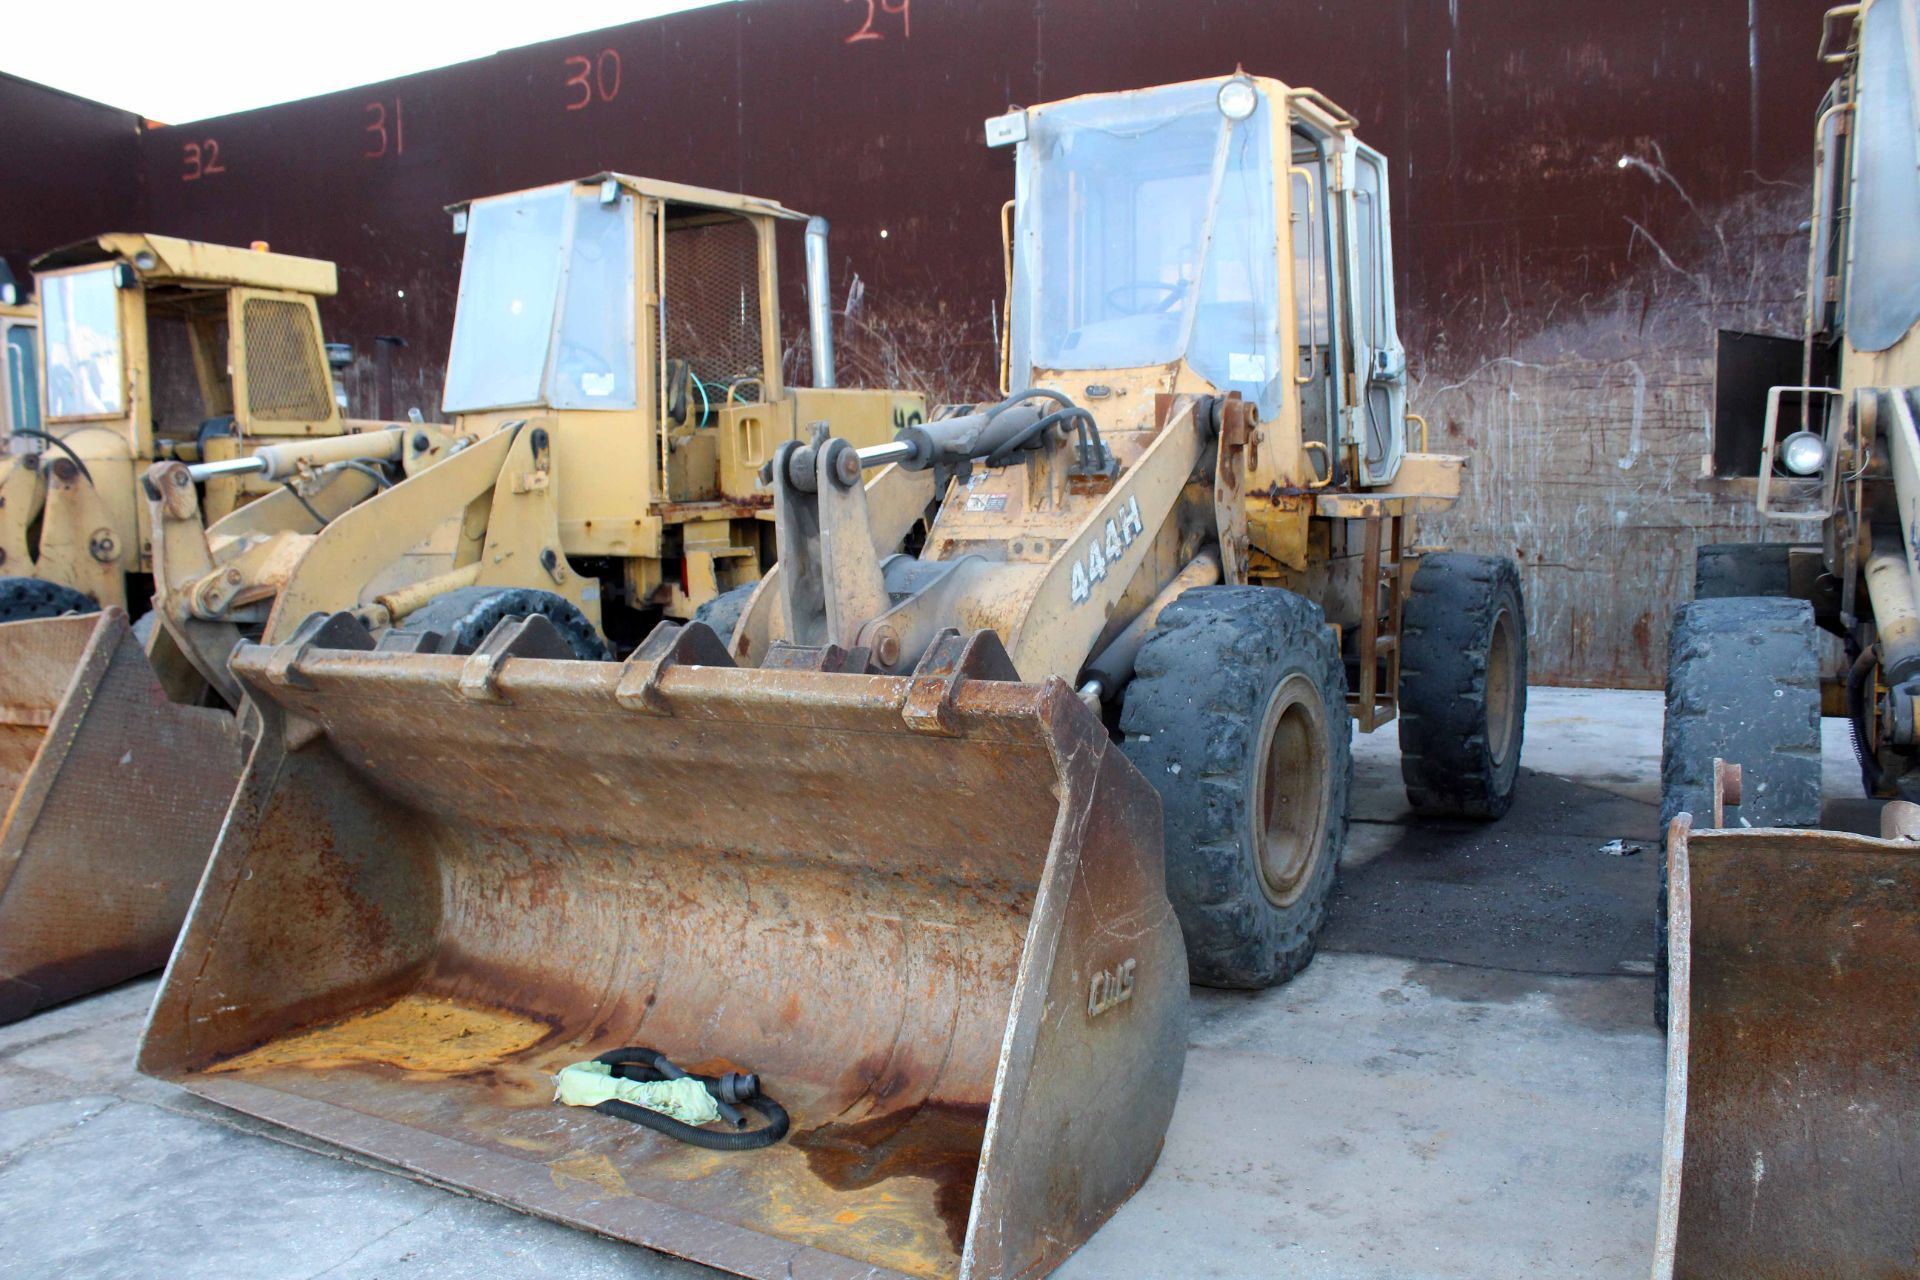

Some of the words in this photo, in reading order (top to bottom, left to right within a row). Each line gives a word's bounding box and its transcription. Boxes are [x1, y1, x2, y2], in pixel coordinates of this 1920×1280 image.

[564, 47, 622, 111] 30
[365, 97, 403, 158] 31
[182, 138, 225, 181] 32
[1071, 494, 1144, 604] 444H
